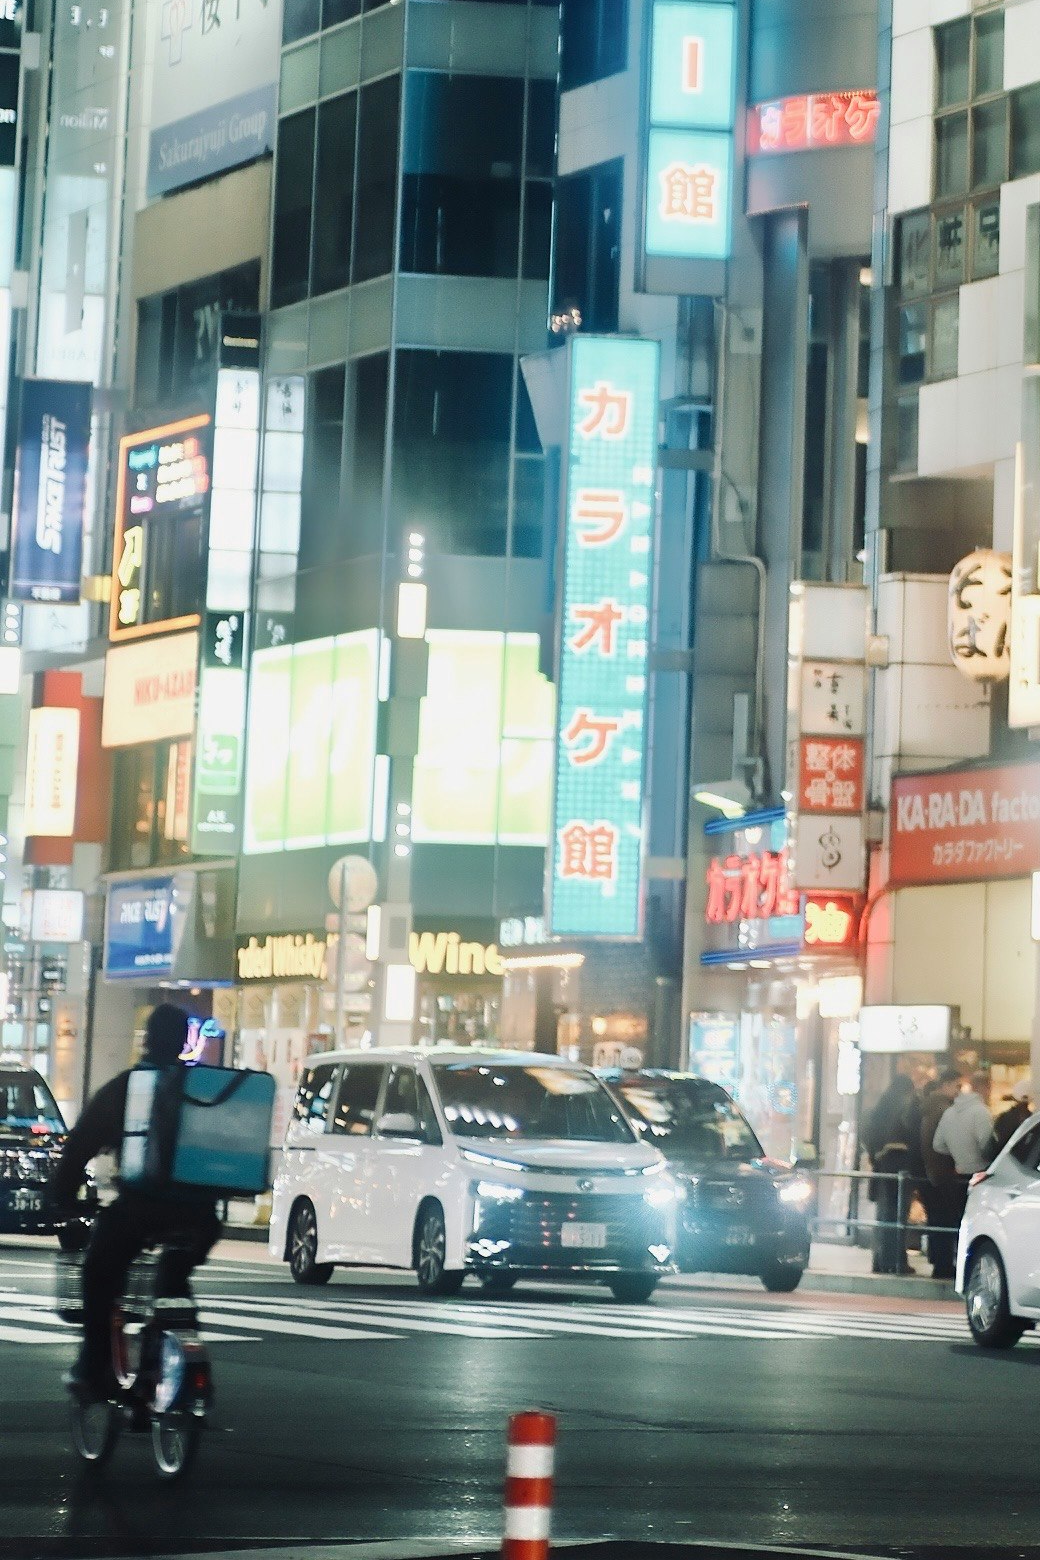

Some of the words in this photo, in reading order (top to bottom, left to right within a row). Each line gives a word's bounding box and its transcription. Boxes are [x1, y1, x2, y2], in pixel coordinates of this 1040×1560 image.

[229, 110, 268, 144] Group
[560, 384, 631, 880] カラオケ館
[408, 931, 506, 976] Wine
